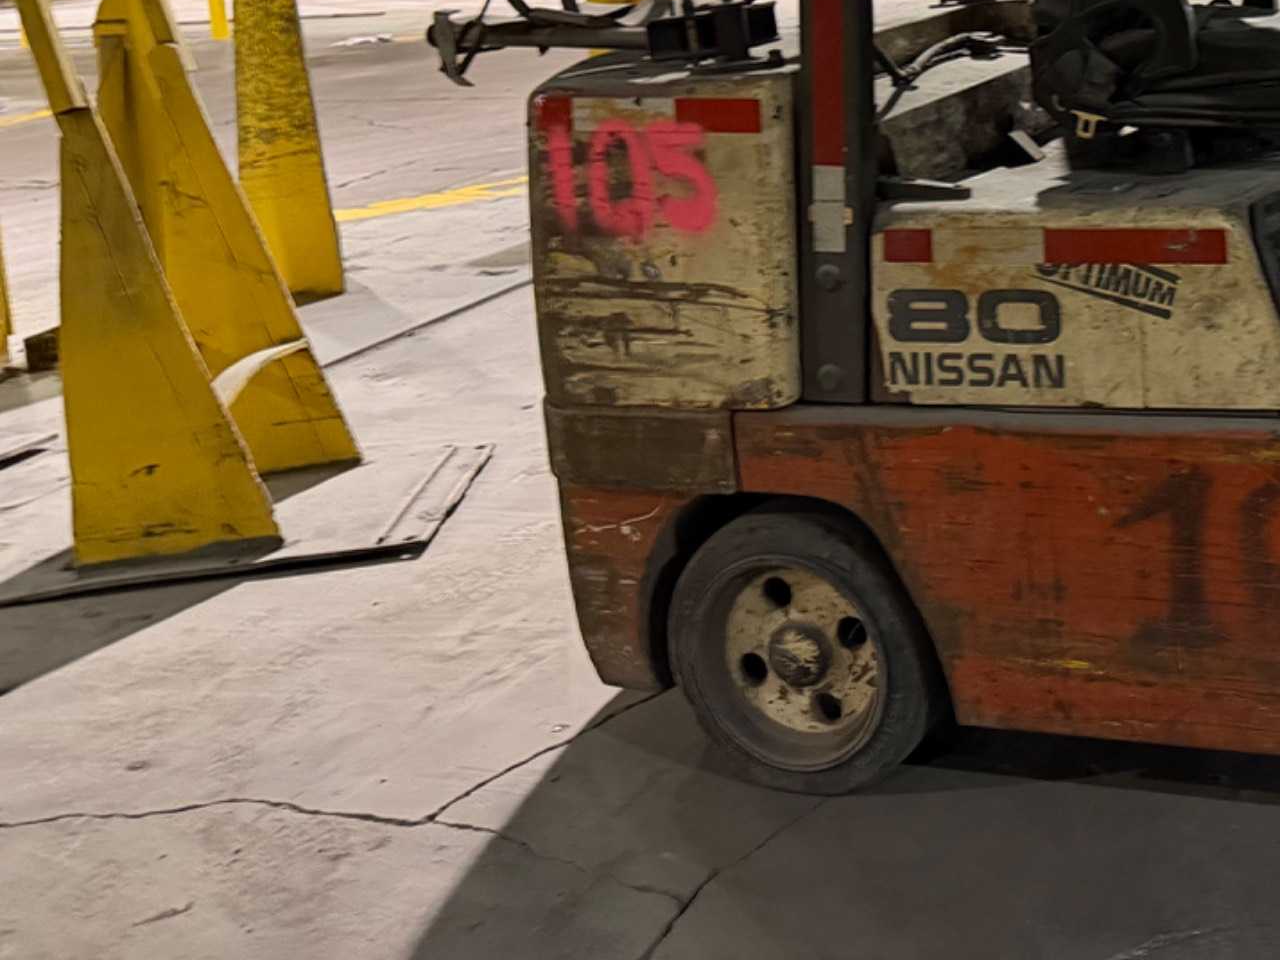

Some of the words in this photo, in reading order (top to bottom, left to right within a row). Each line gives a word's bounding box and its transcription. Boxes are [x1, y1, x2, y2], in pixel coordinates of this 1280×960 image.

[546, 118, 719, 237] 105
[886, 288, 1062, 344] 80
[887, 350, 1066, 389] NISSAN
